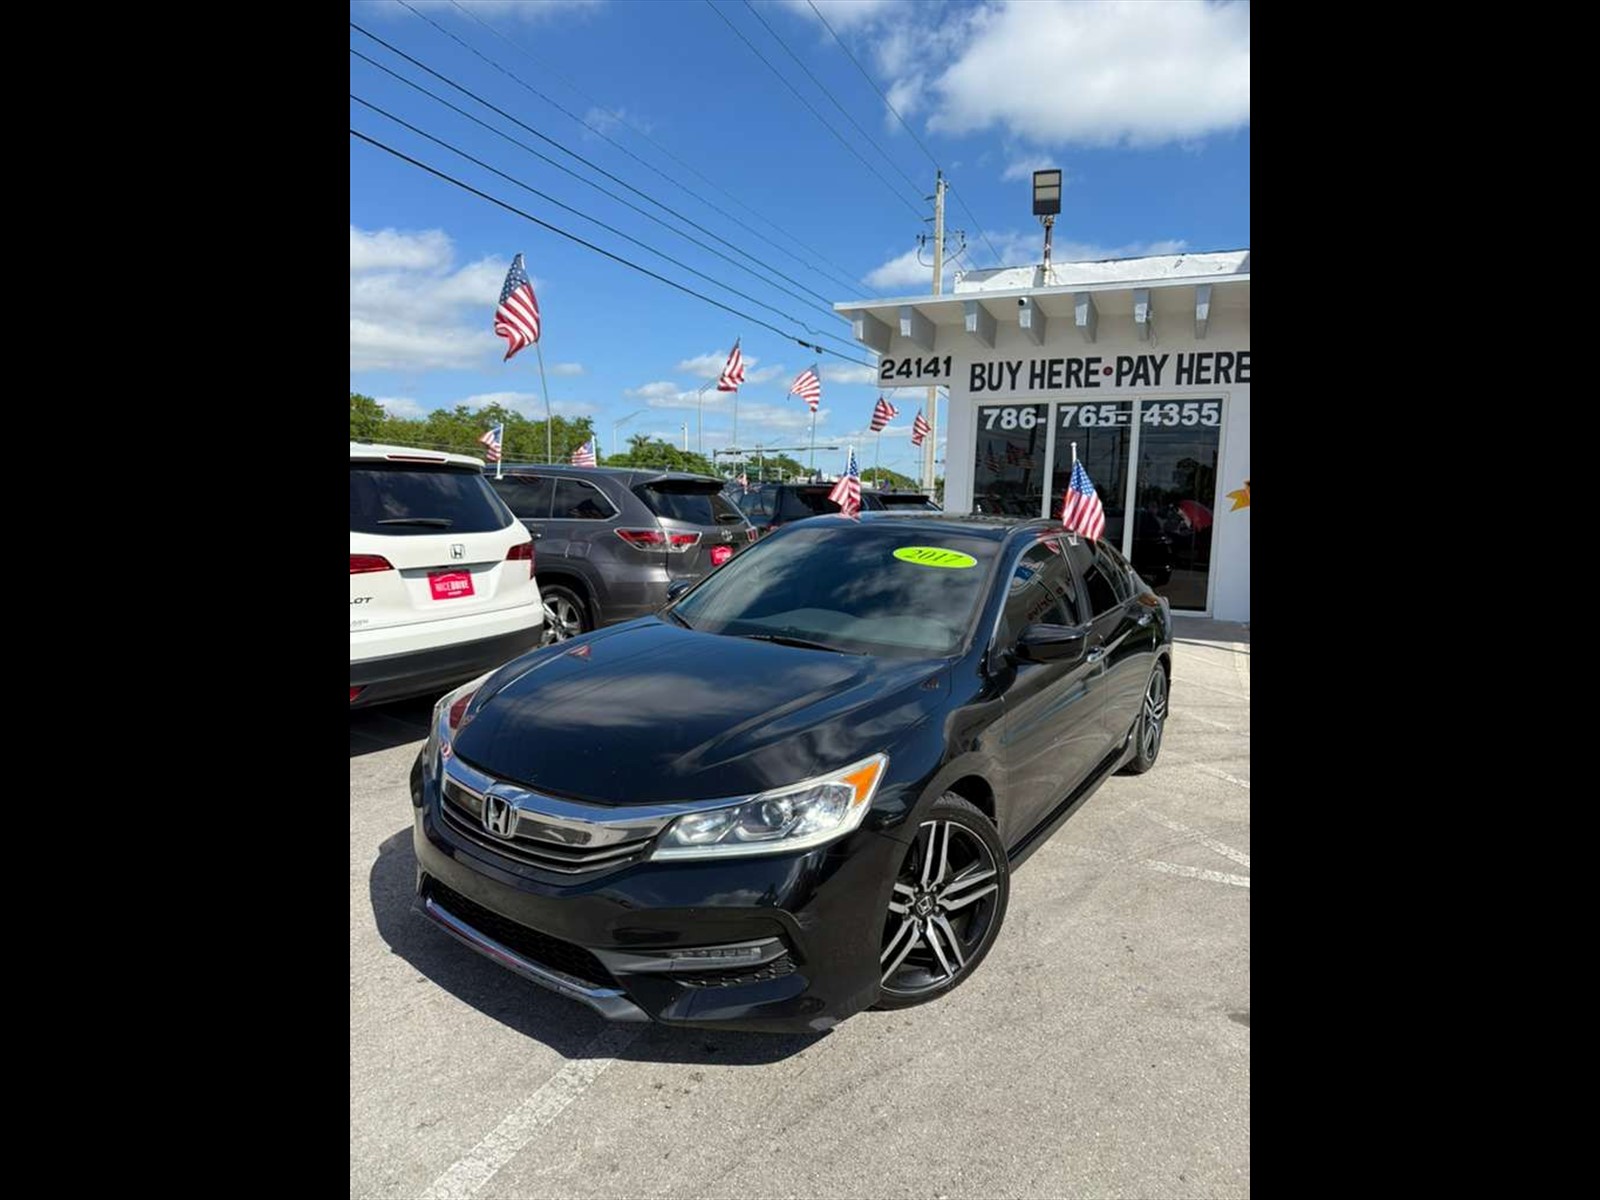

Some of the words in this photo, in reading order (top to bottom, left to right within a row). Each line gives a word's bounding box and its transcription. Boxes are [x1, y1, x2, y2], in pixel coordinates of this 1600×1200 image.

[881, 356, 952, 380] 24141
[970, 361, 1022, 392] BUY
[1029, 357, 1102, 390] HERE
[1115, 353, 1169, 387] PAY
[1175, 351, 1250, 385] HERE
[983, 407, 1047, 430] 786-
[1060, 404, 1128, 428] 765-
[1142, 402, 1220, 427] 4355
[903, 548, 964, 563] 2017
